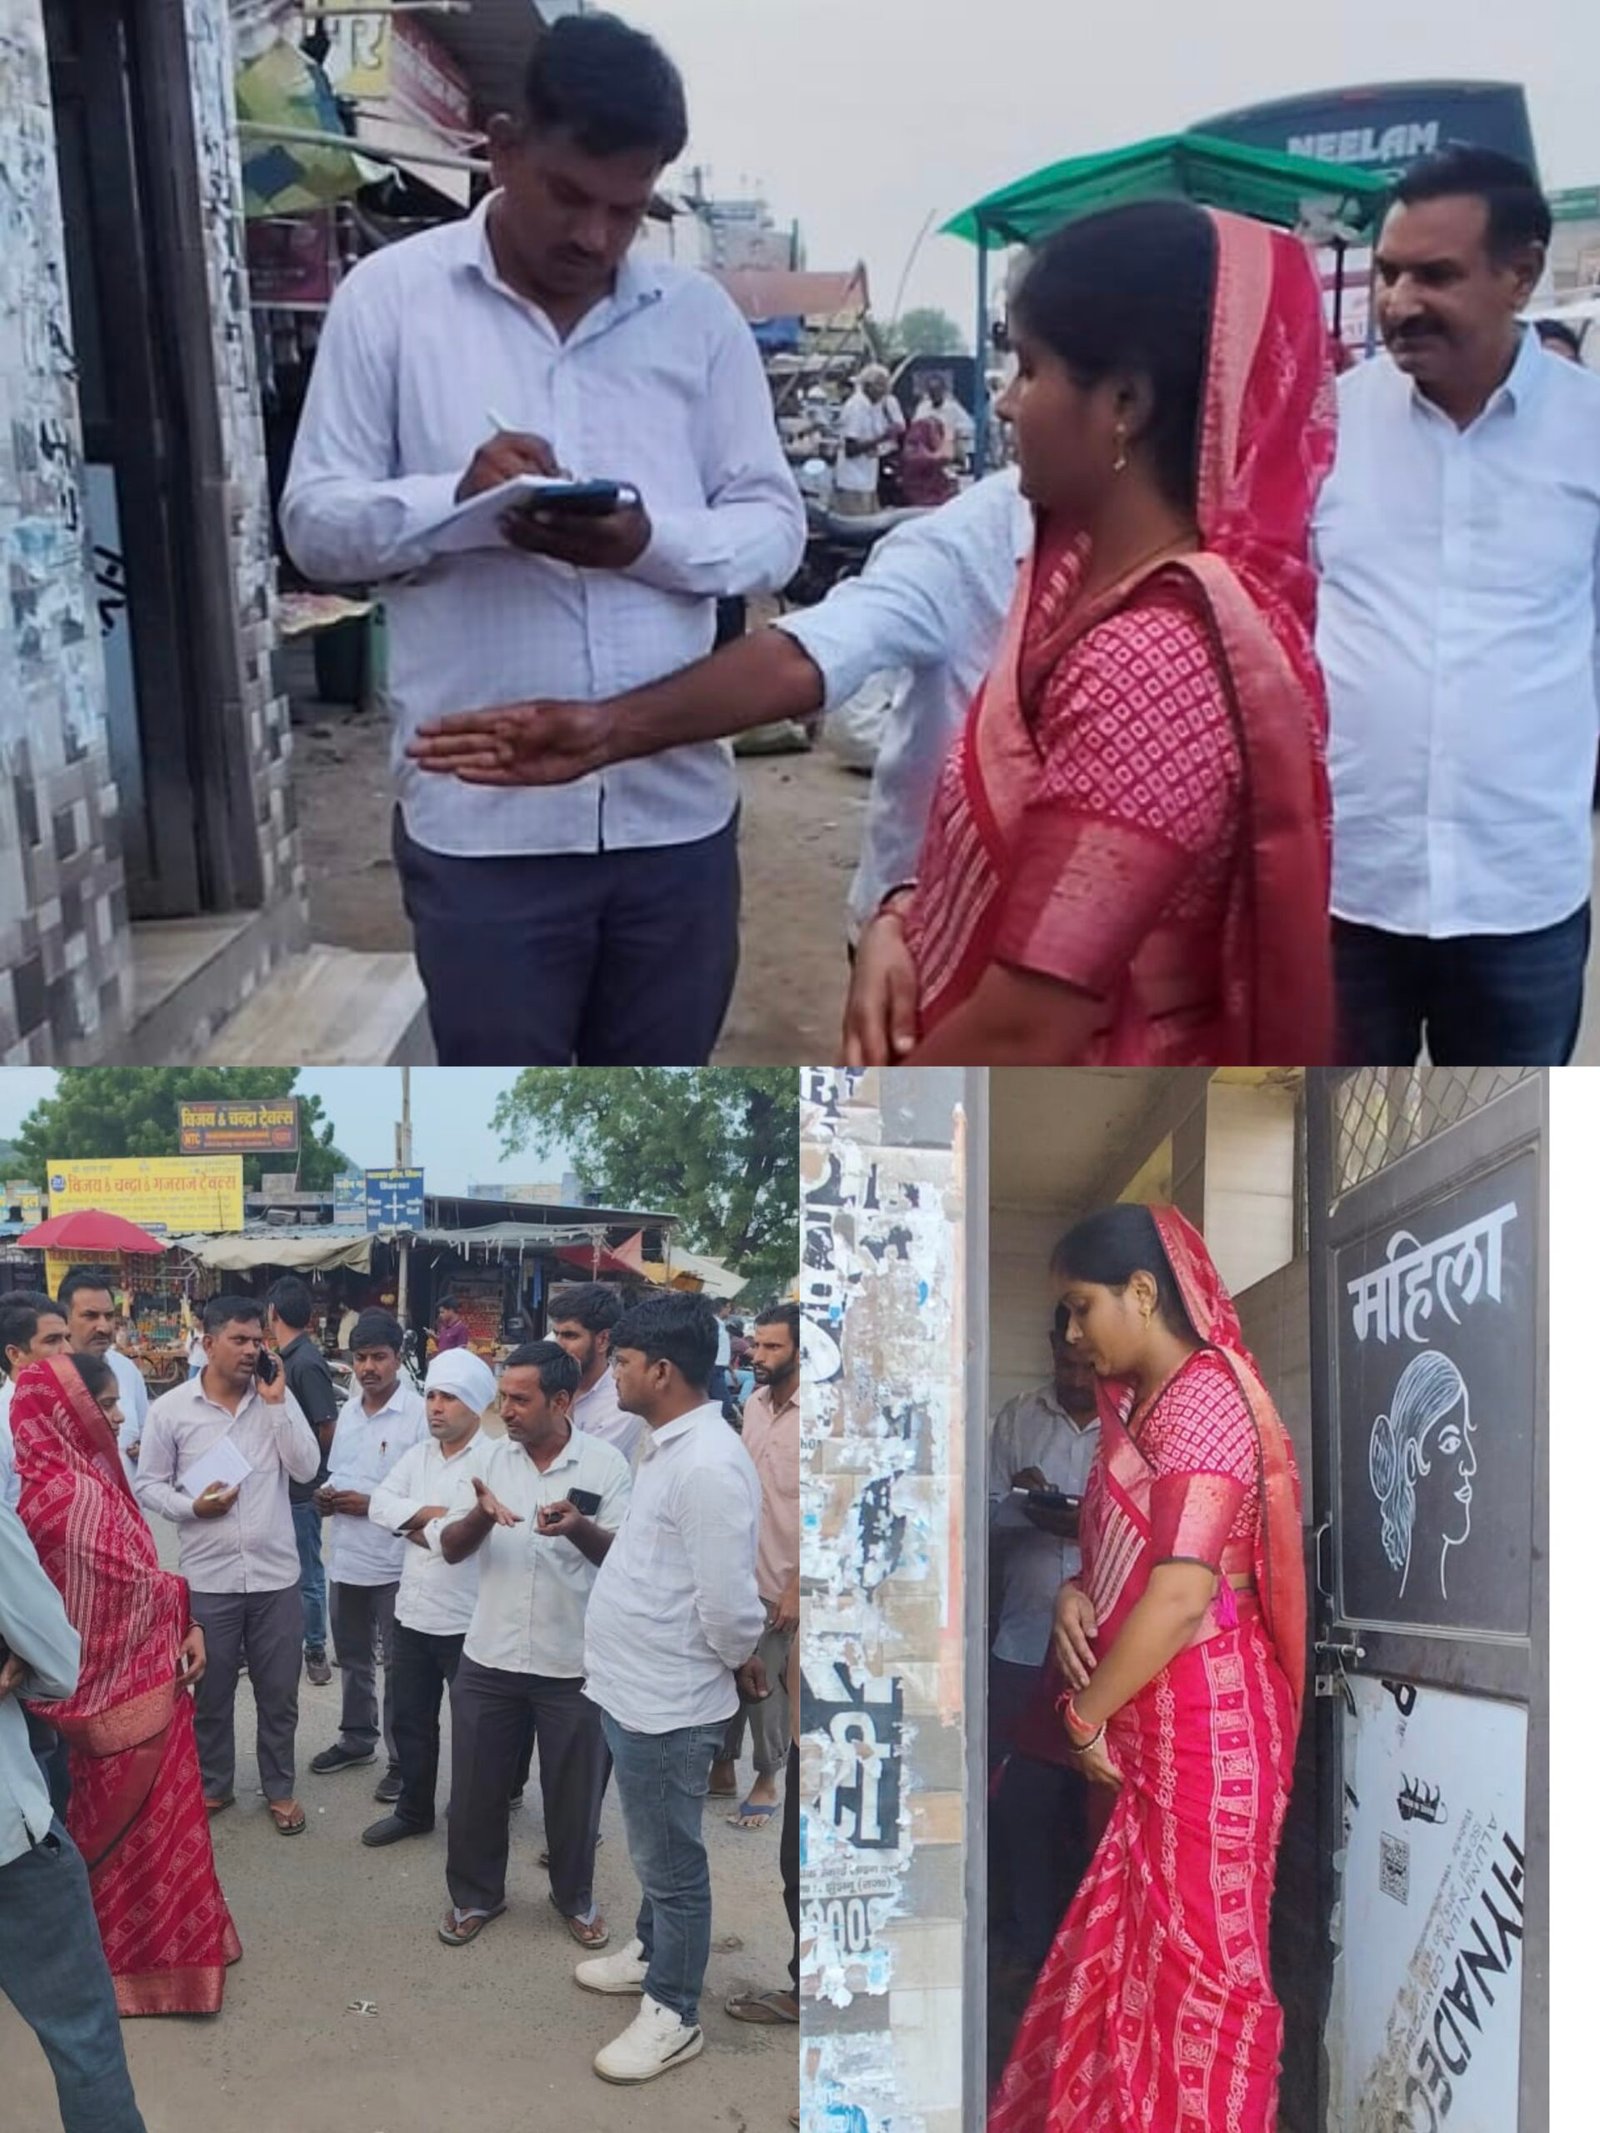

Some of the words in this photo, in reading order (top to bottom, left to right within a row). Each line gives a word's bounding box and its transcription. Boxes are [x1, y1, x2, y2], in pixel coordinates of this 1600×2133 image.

[1287, 121, 1440, 162] NEELAM
[1347, 1201, 1518, 1344] महिला
[1445, 1811, 1497, 1951] ALUMINIUM
